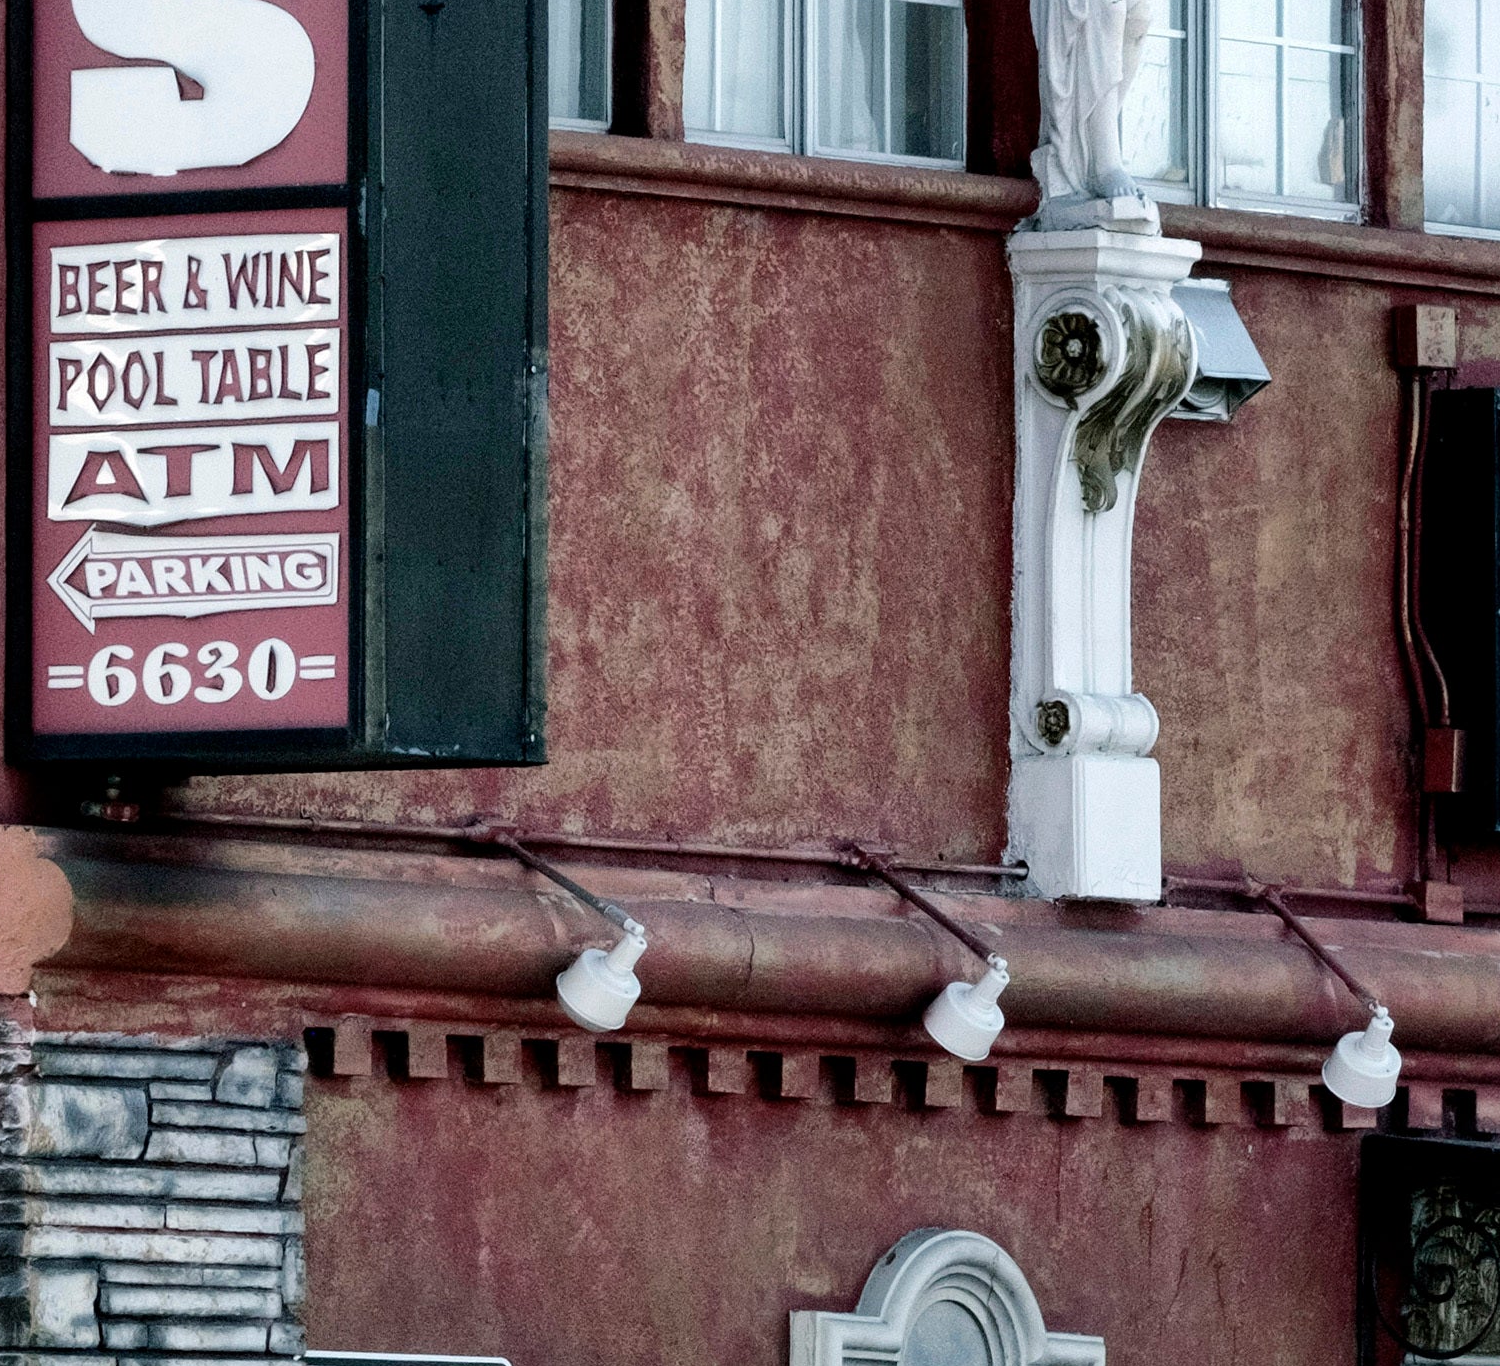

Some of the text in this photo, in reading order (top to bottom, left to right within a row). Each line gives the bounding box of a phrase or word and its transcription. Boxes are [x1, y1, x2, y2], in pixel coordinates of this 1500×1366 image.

[58, 248, 332, 317] BEER & WINE
[58, 342, 332, 413] POOL TABLE
[62, 439, 330, 510] ATM
[84, 550, 322, 598] PARKING
